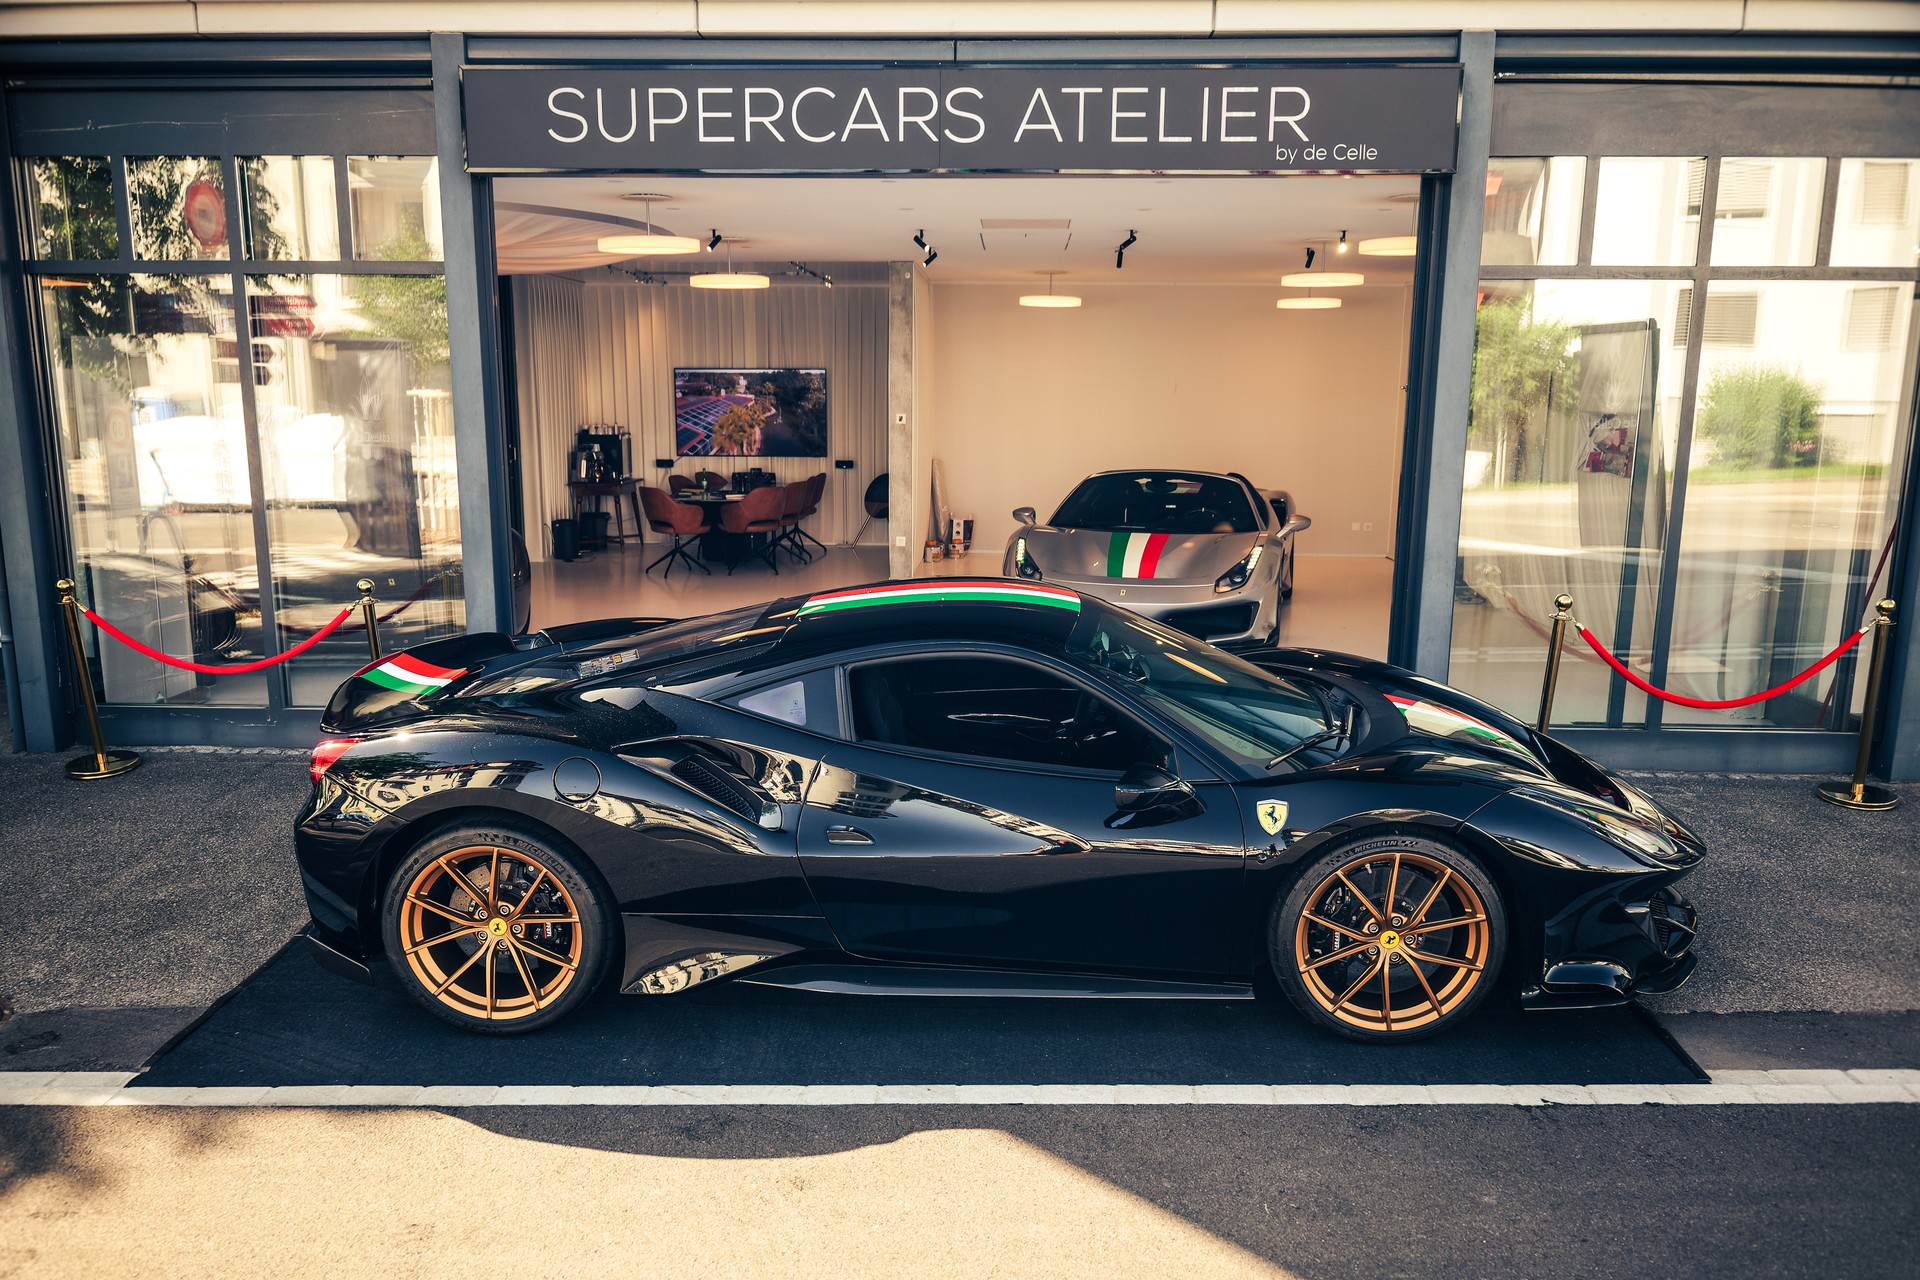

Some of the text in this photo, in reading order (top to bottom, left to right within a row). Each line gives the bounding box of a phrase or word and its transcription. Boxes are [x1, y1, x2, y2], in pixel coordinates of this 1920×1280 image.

[547, 86, 1312, 144] SUPERCARS ATELIER
[1276, 143, 1379, 165] by de Celle
[516, 839, 565, 874] MICHELIN
[1354, 840, 1398, 853] MICHELIN
